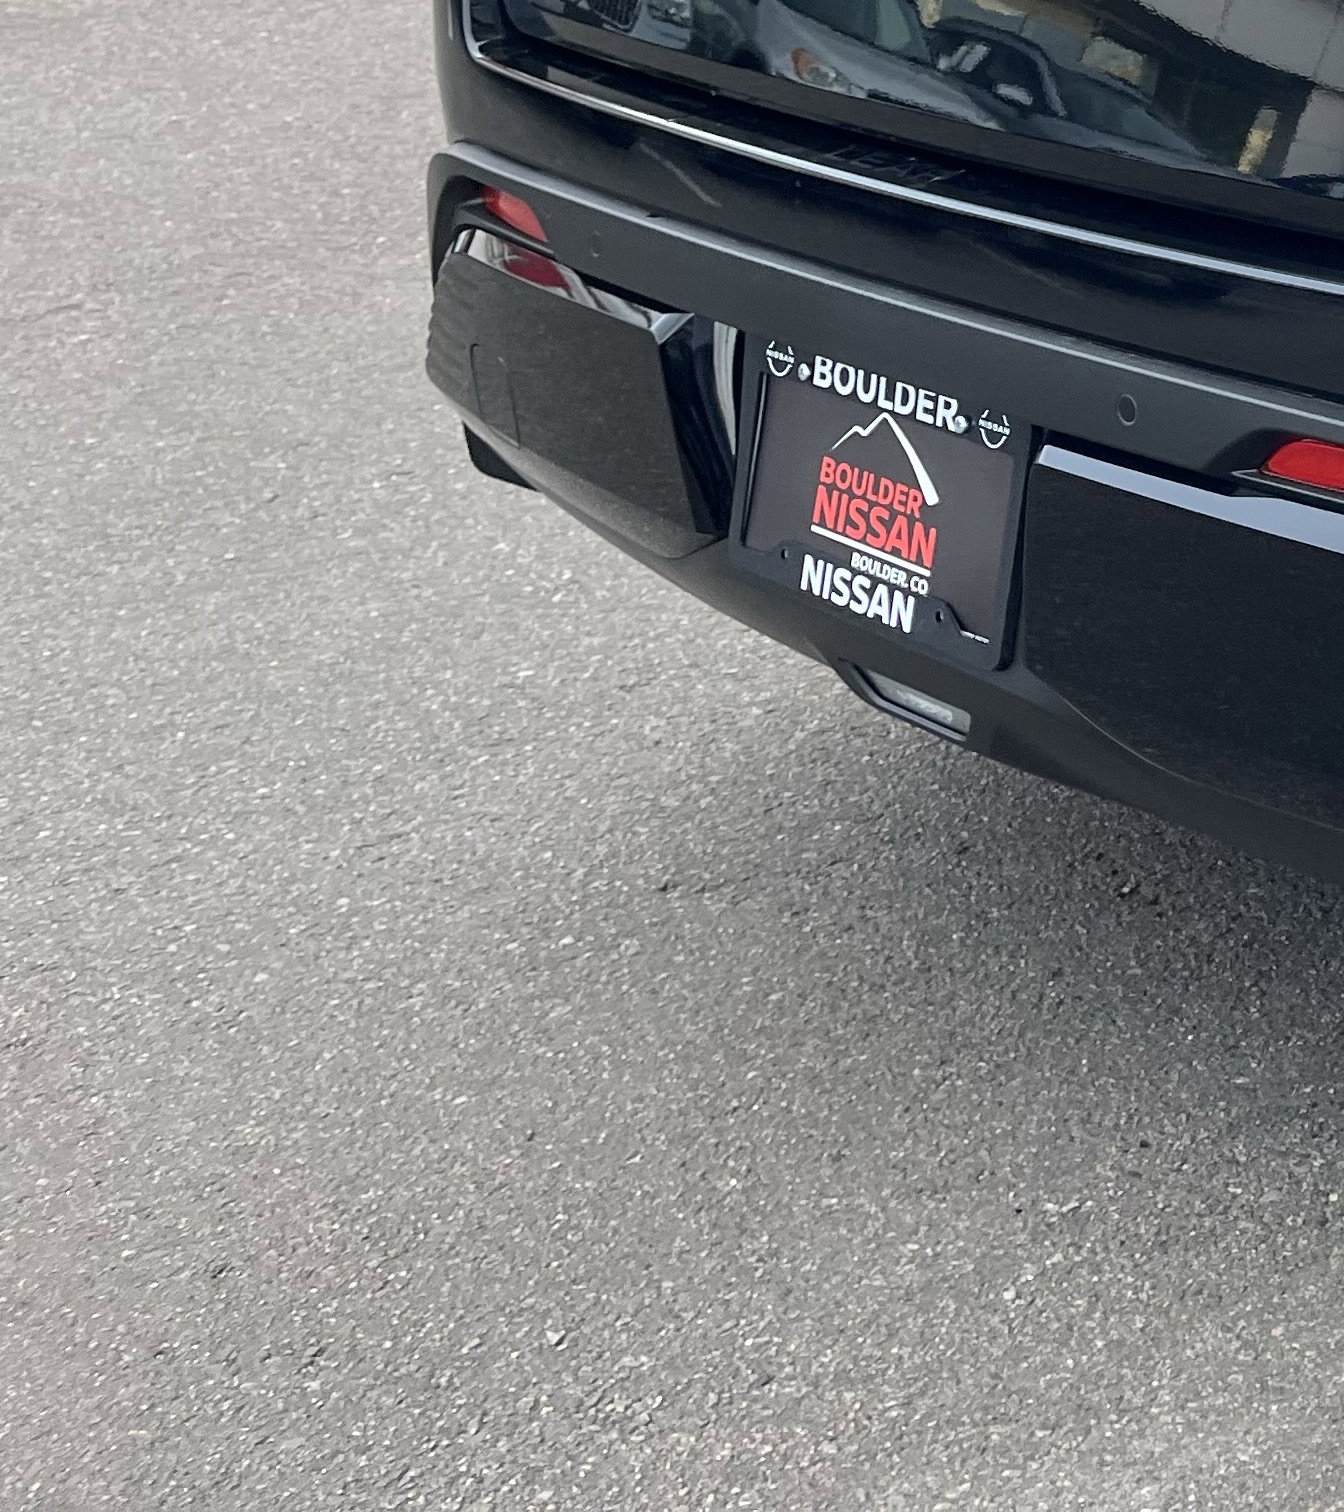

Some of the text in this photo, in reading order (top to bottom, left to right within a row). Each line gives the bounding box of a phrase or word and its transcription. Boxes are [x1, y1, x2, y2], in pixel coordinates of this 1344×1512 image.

[766, 347, 795, 365] NISSAN
[812, 355, 959, 433] BOULDER
[978, 417, 1011, 437] NISSAN
[819, 456, 924, 519] BOULDER
[812, 485, 938, 569] NISSAN
[800, 553, 916, 634] NISSAN
[909, 575, 929, 595] CO
